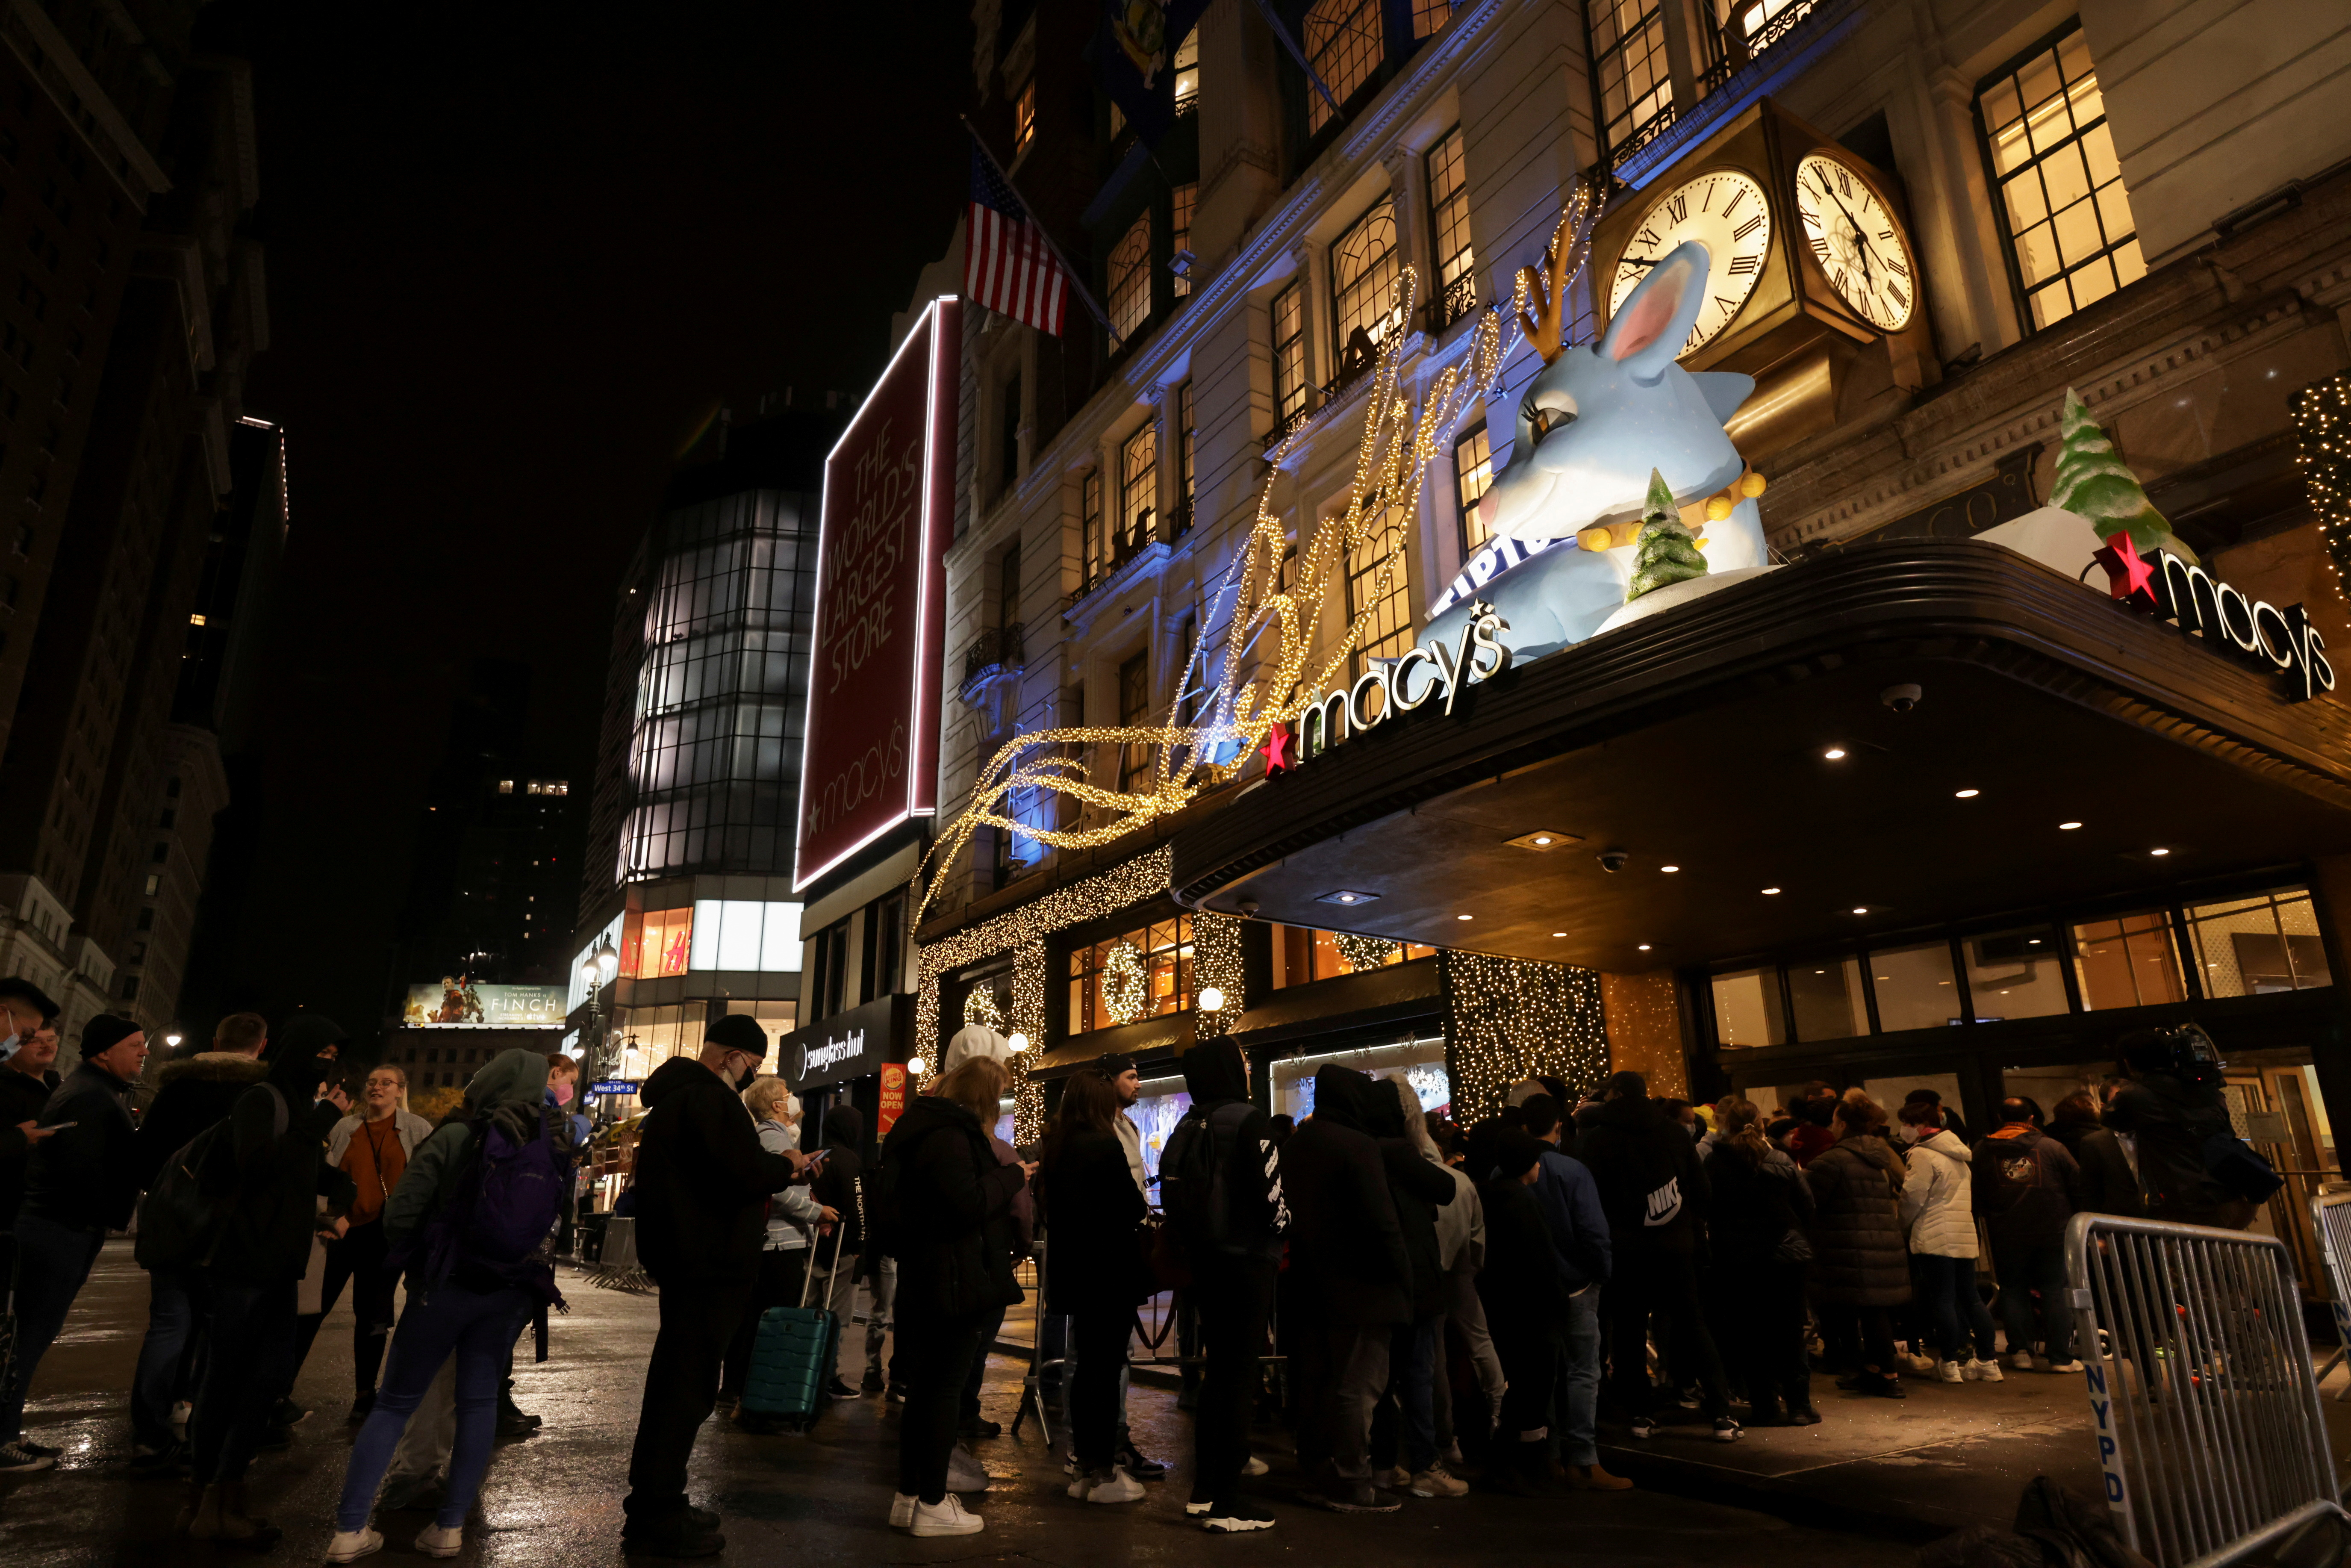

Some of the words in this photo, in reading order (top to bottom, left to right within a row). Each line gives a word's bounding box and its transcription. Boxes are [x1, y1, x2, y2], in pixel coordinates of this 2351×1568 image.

[1667, 195, 1688, 230] XII
[855, 417, 892, 504] THE
[828, 439, 917, 591] WORLD'S
[822, 503, 911, 649] LARGEST
[2160, 549, 2335, 699] macy's
[830, 584, 894, 694] STORE
[1299, 597, 1507, 761] macy's
[822, 718, 903, 832] macy's
[492, 998, 556, 1011] FINCH
[807, 1036, 846, 1073] sunglass
[847, 1029, 864, 1058] hut
[881, 1101, 903, 1109] OPEN
[883, 1092, 902, 1100] NOW
[886, 1076, 902, 1085] KING
[2085, 1365, 2125, 1503] NYPD
